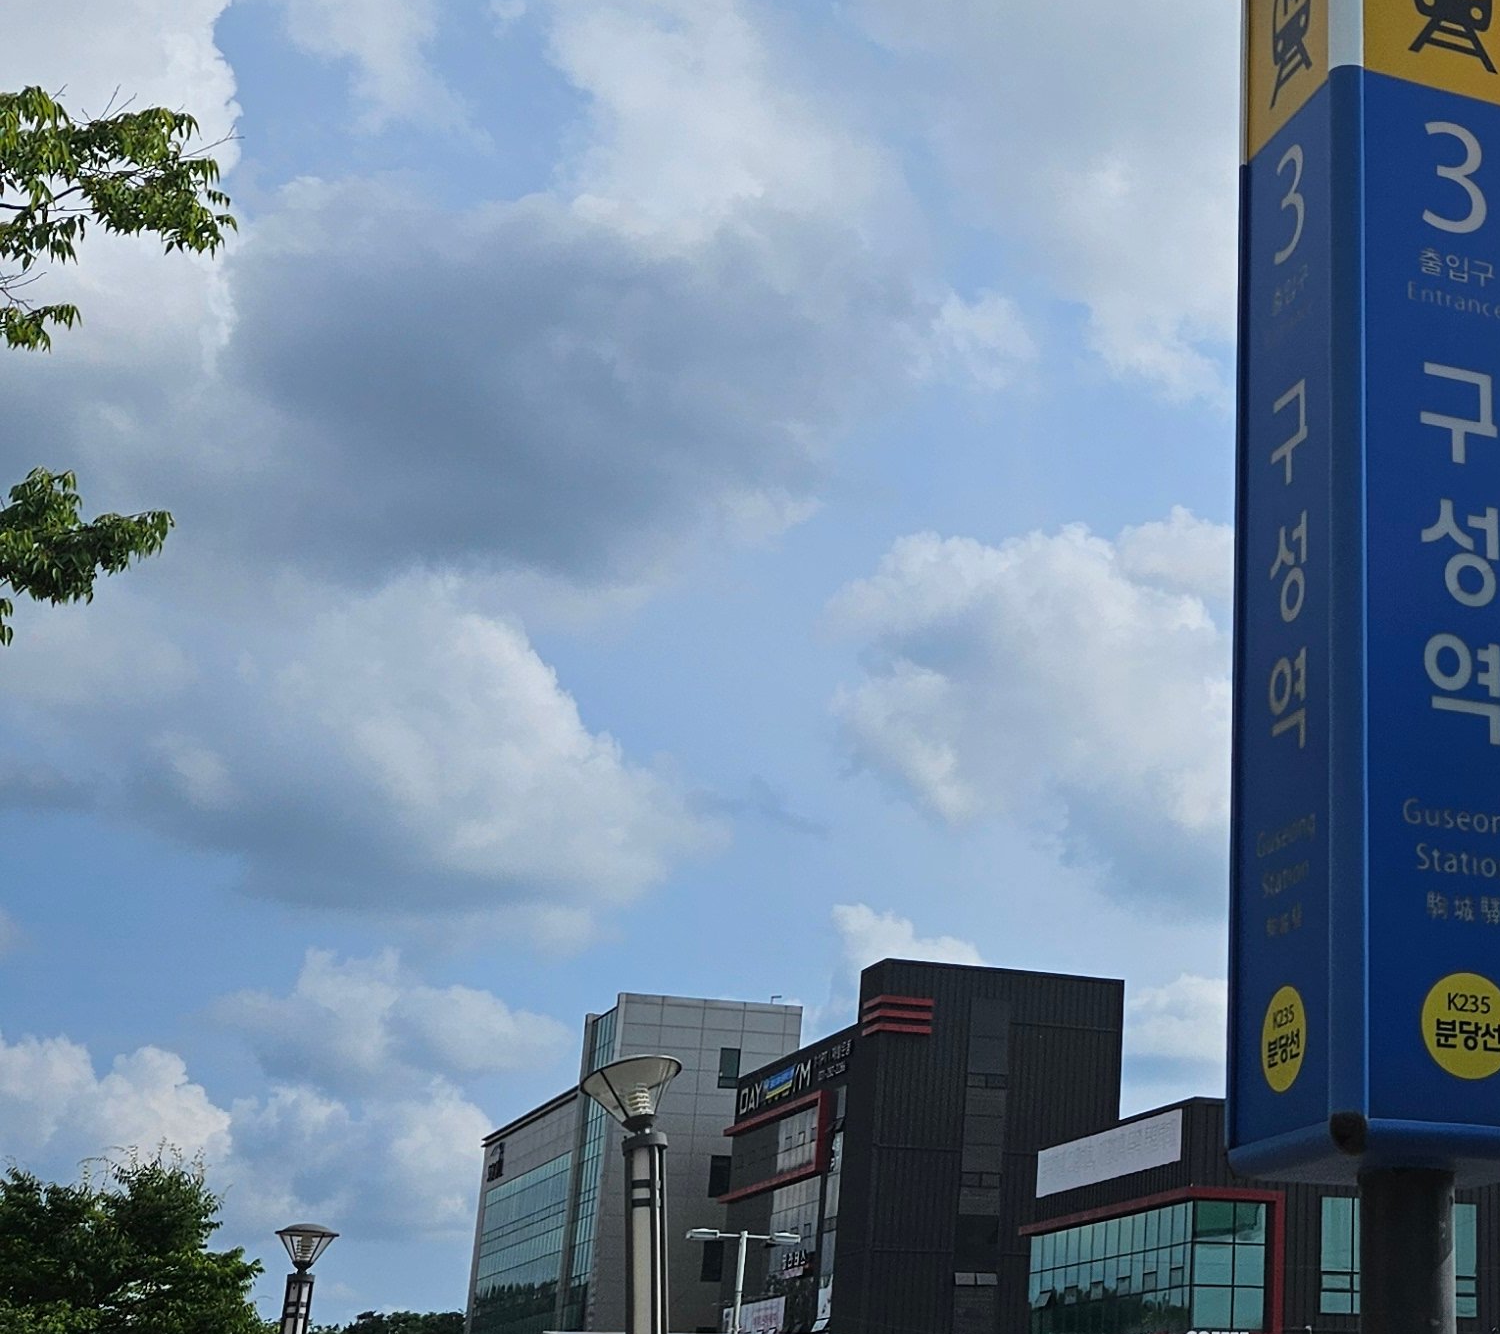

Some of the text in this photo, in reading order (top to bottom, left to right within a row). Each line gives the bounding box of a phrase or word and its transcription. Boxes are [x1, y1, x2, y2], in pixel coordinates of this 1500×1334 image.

[1422, 121, 1489, 234] 3
[1274, 144, 1305, 265] 3
[1419, 248, 1496, 287] 출입구
[1269, 378, 1309, 749] 구성역
[1272, 1004, 1295, 1029] K235
[1447, 992, 1492, 1015] K235
[1267, 1032, 1301, 1069] 분당선
